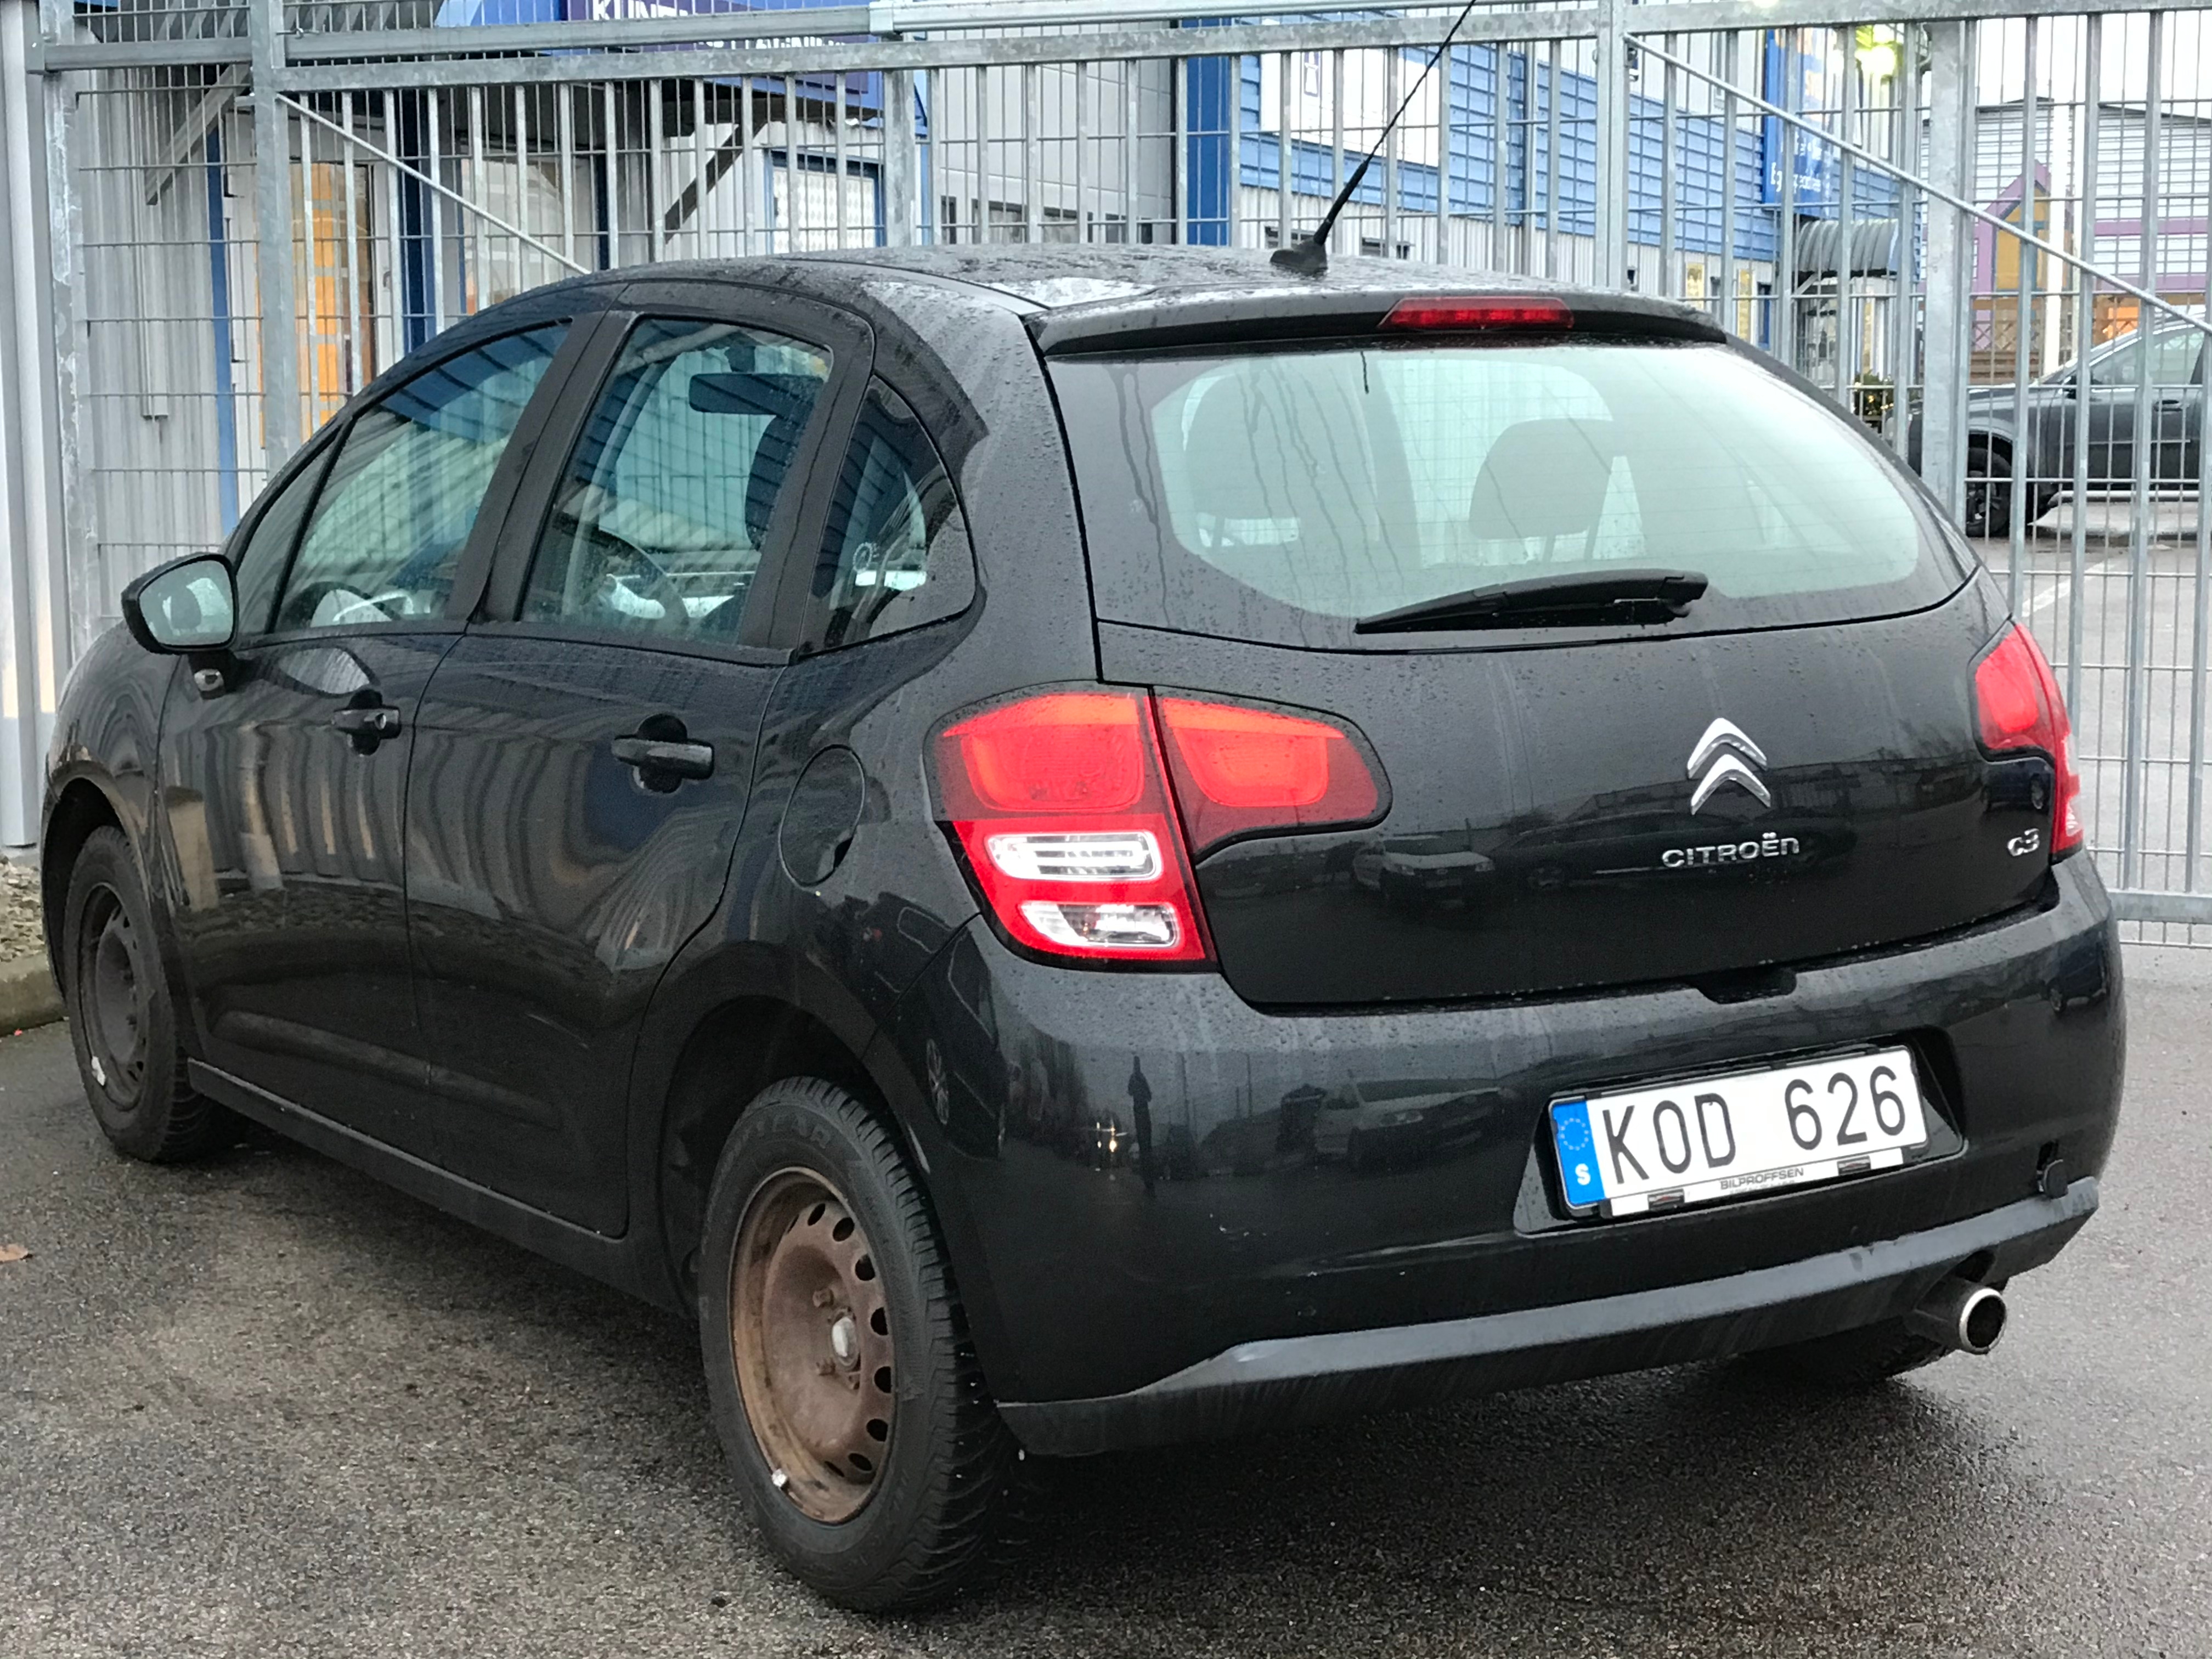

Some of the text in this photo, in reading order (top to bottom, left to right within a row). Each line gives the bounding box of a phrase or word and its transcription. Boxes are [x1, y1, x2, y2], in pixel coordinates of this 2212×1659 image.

[1602, 1065, 1906, 1185] KOD 626
[1575, 1163, 1591, 1185] S
[1720, 1167, 1804, 1190] BILPROFFSEN
